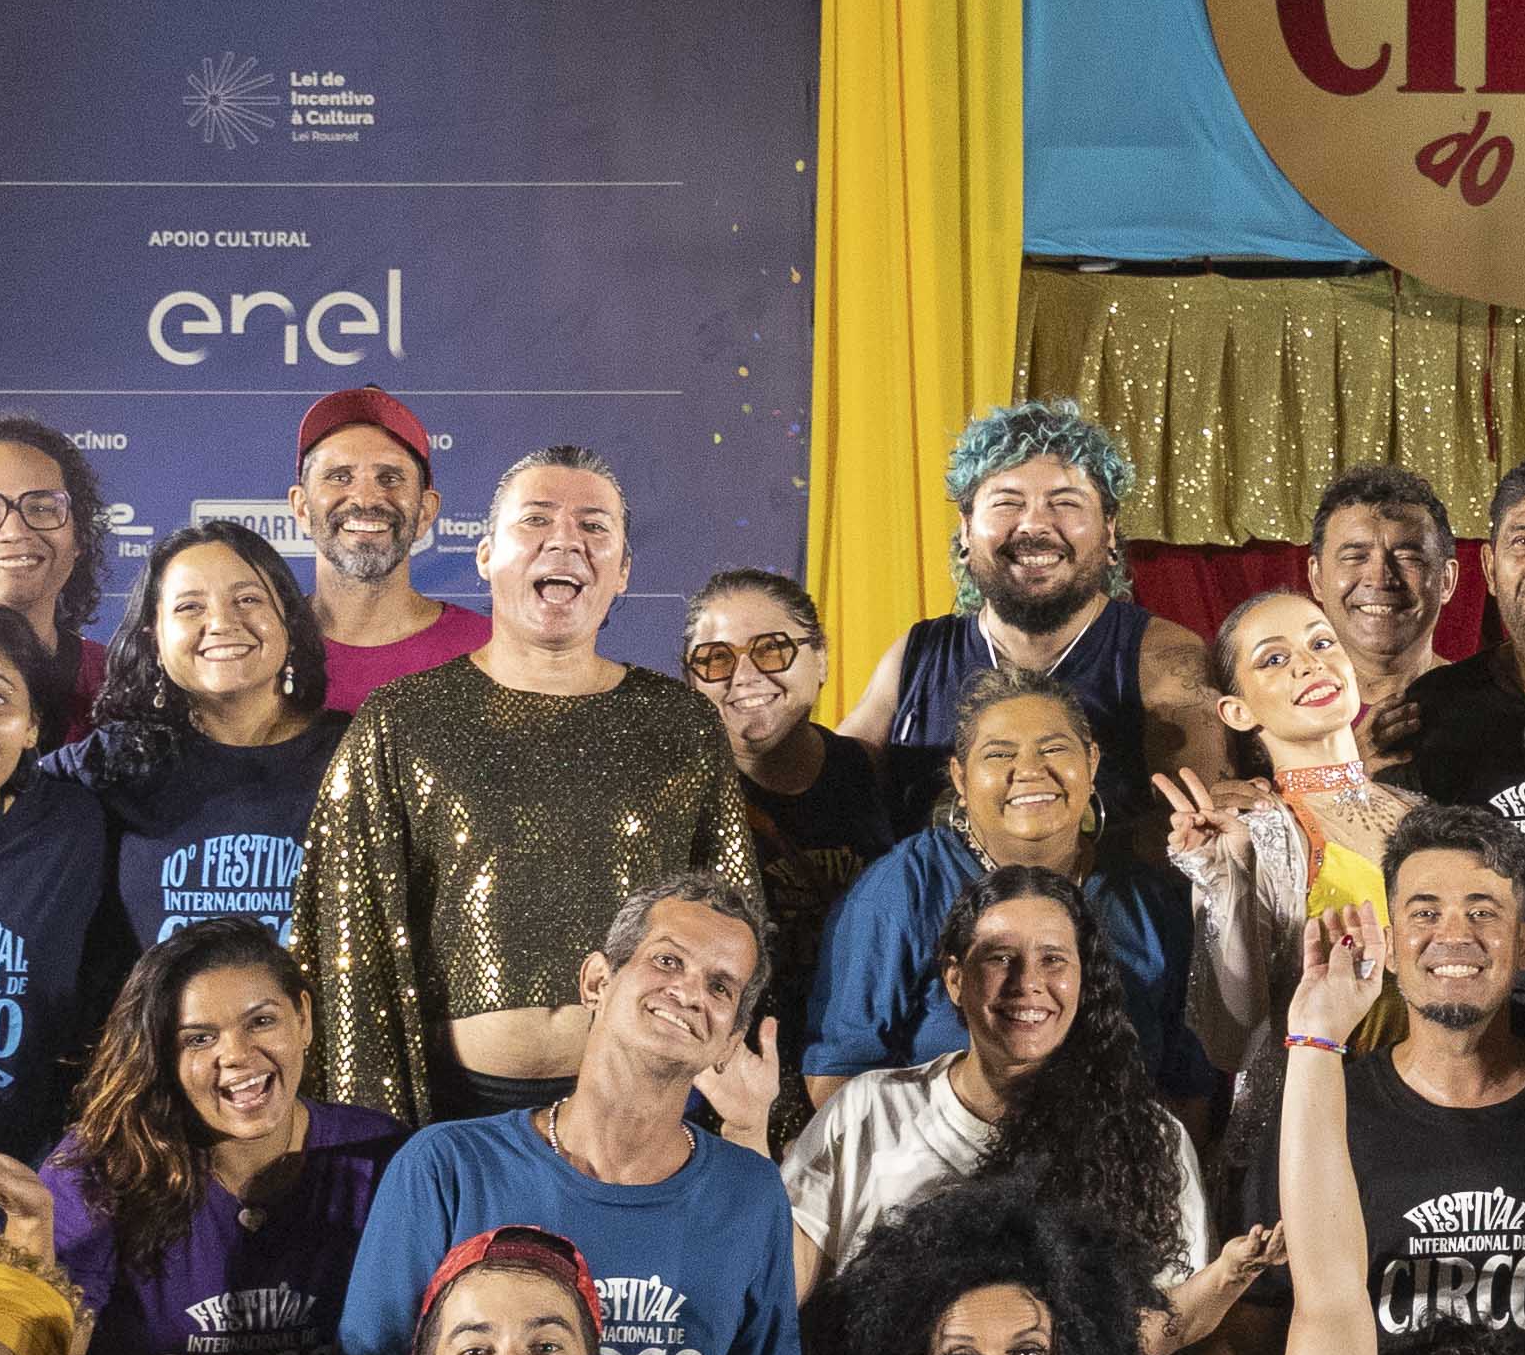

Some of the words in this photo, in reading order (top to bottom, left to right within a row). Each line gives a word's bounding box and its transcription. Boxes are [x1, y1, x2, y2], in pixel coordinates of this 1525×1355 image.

[291, 71, 318, 86] Lei
[321, 71, 345, 86] de
[291, 91, 375, 105] Incentivo
[291, 110, 302, 125] à
[306, 110, 374, 125] Cultura
[292, 131, 309, 142] Lei
[1415, 111, 1515, 206] do
[149, 231, 209, 247] APOIO
[215, 231, 311, 247] CULTURAL
[147, 268, 406, 365] enel
[201, 834, 305, 887] FESTIVA
[7, 977, 28, 994] DE
[1409, 1234, 1510, 1255] INTERNACIONAL
[185, 1281, 316, 1332] FESTIVAL
[668, 1327, 684, 1345] DE
